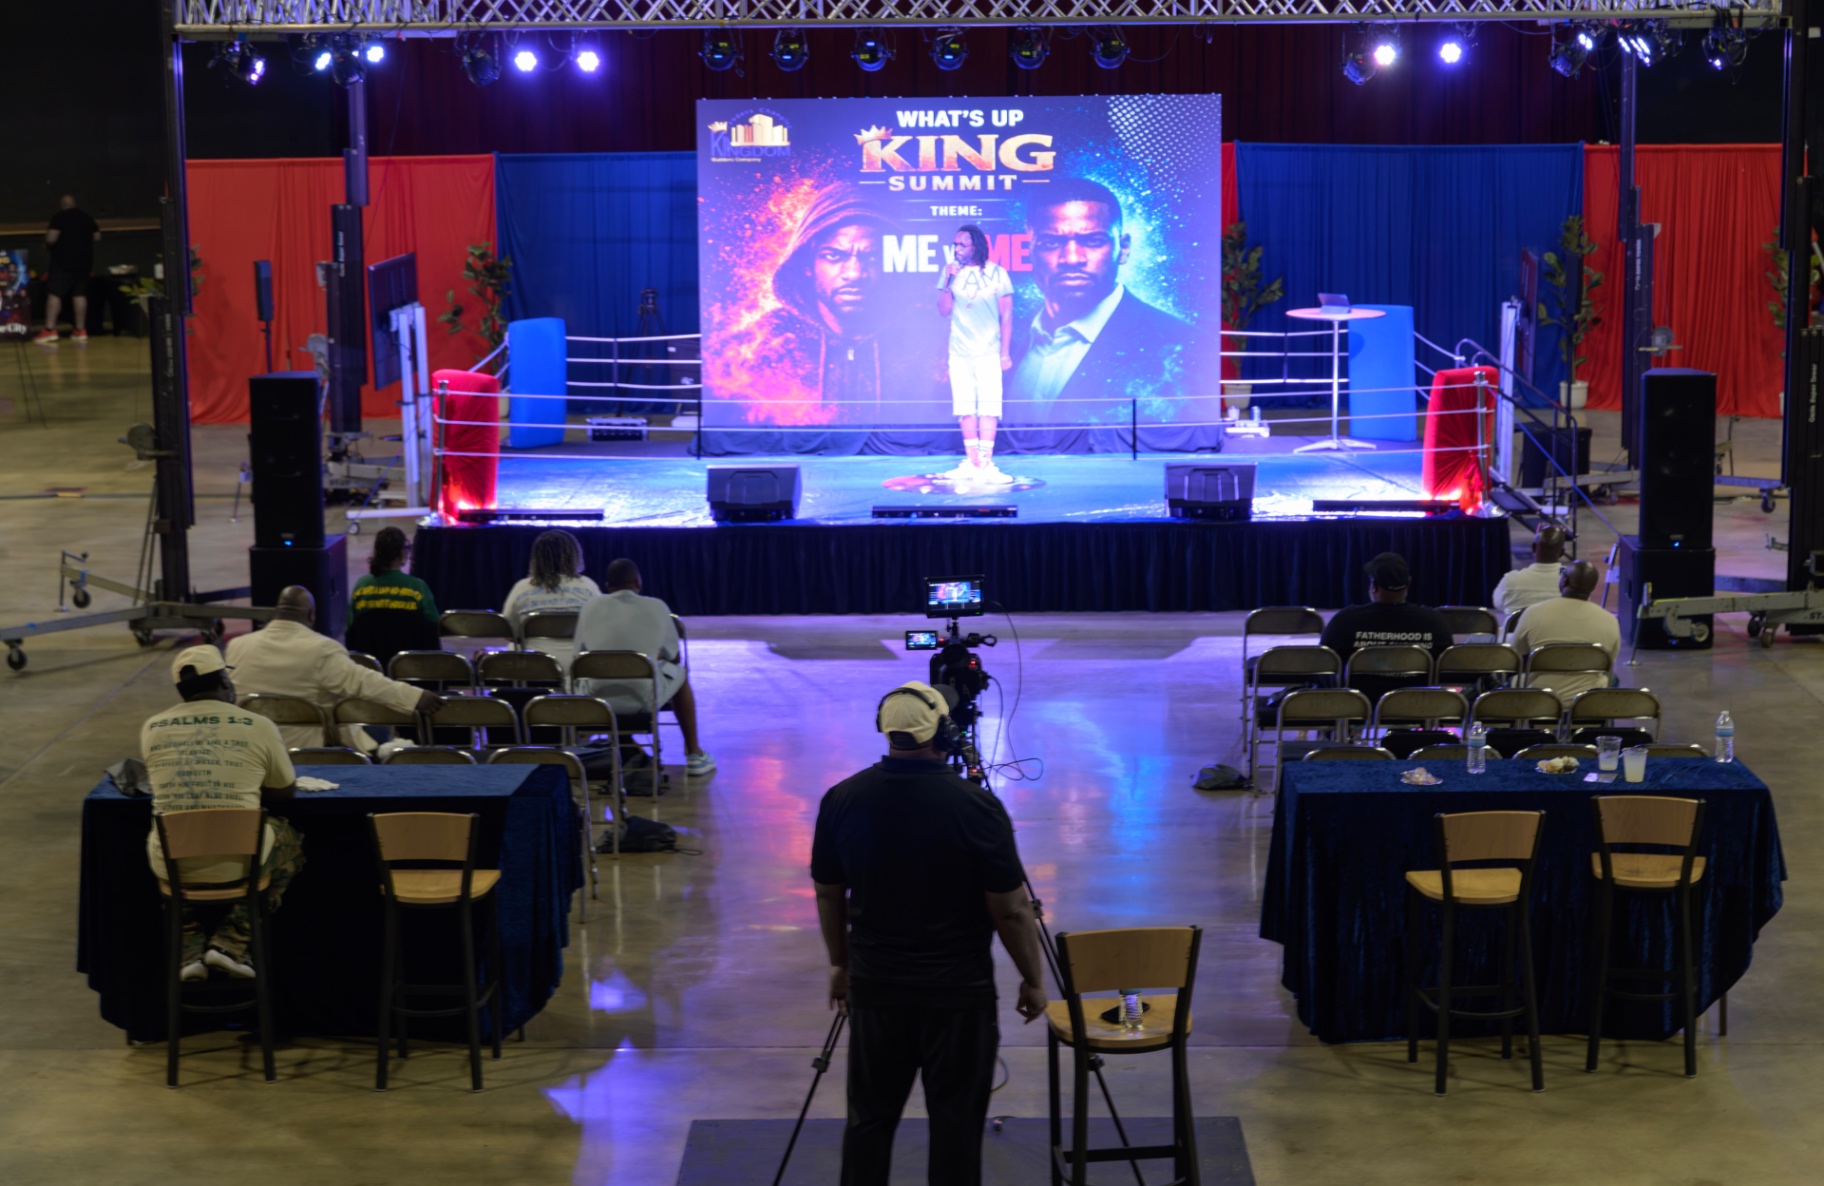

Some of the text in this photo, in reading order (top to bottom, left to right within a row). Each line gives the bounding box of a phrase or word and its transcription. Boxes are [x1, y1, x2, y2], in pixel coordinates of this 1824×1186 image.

[896, 109, 1024, 128] WHAT'S UP
[709, 130, 792, 157] KINGDOM
[859, 133, 1057, 172] KING
[888, 174, 1018, 192] SUMMIT
[929, 205, 983, 217] THEME:
[882, 234, 939, 273] ME
[1355, 631, 1433, 641] FATHERHOOD IS
[150, 716, 254, 729] PSALMS 1:3
